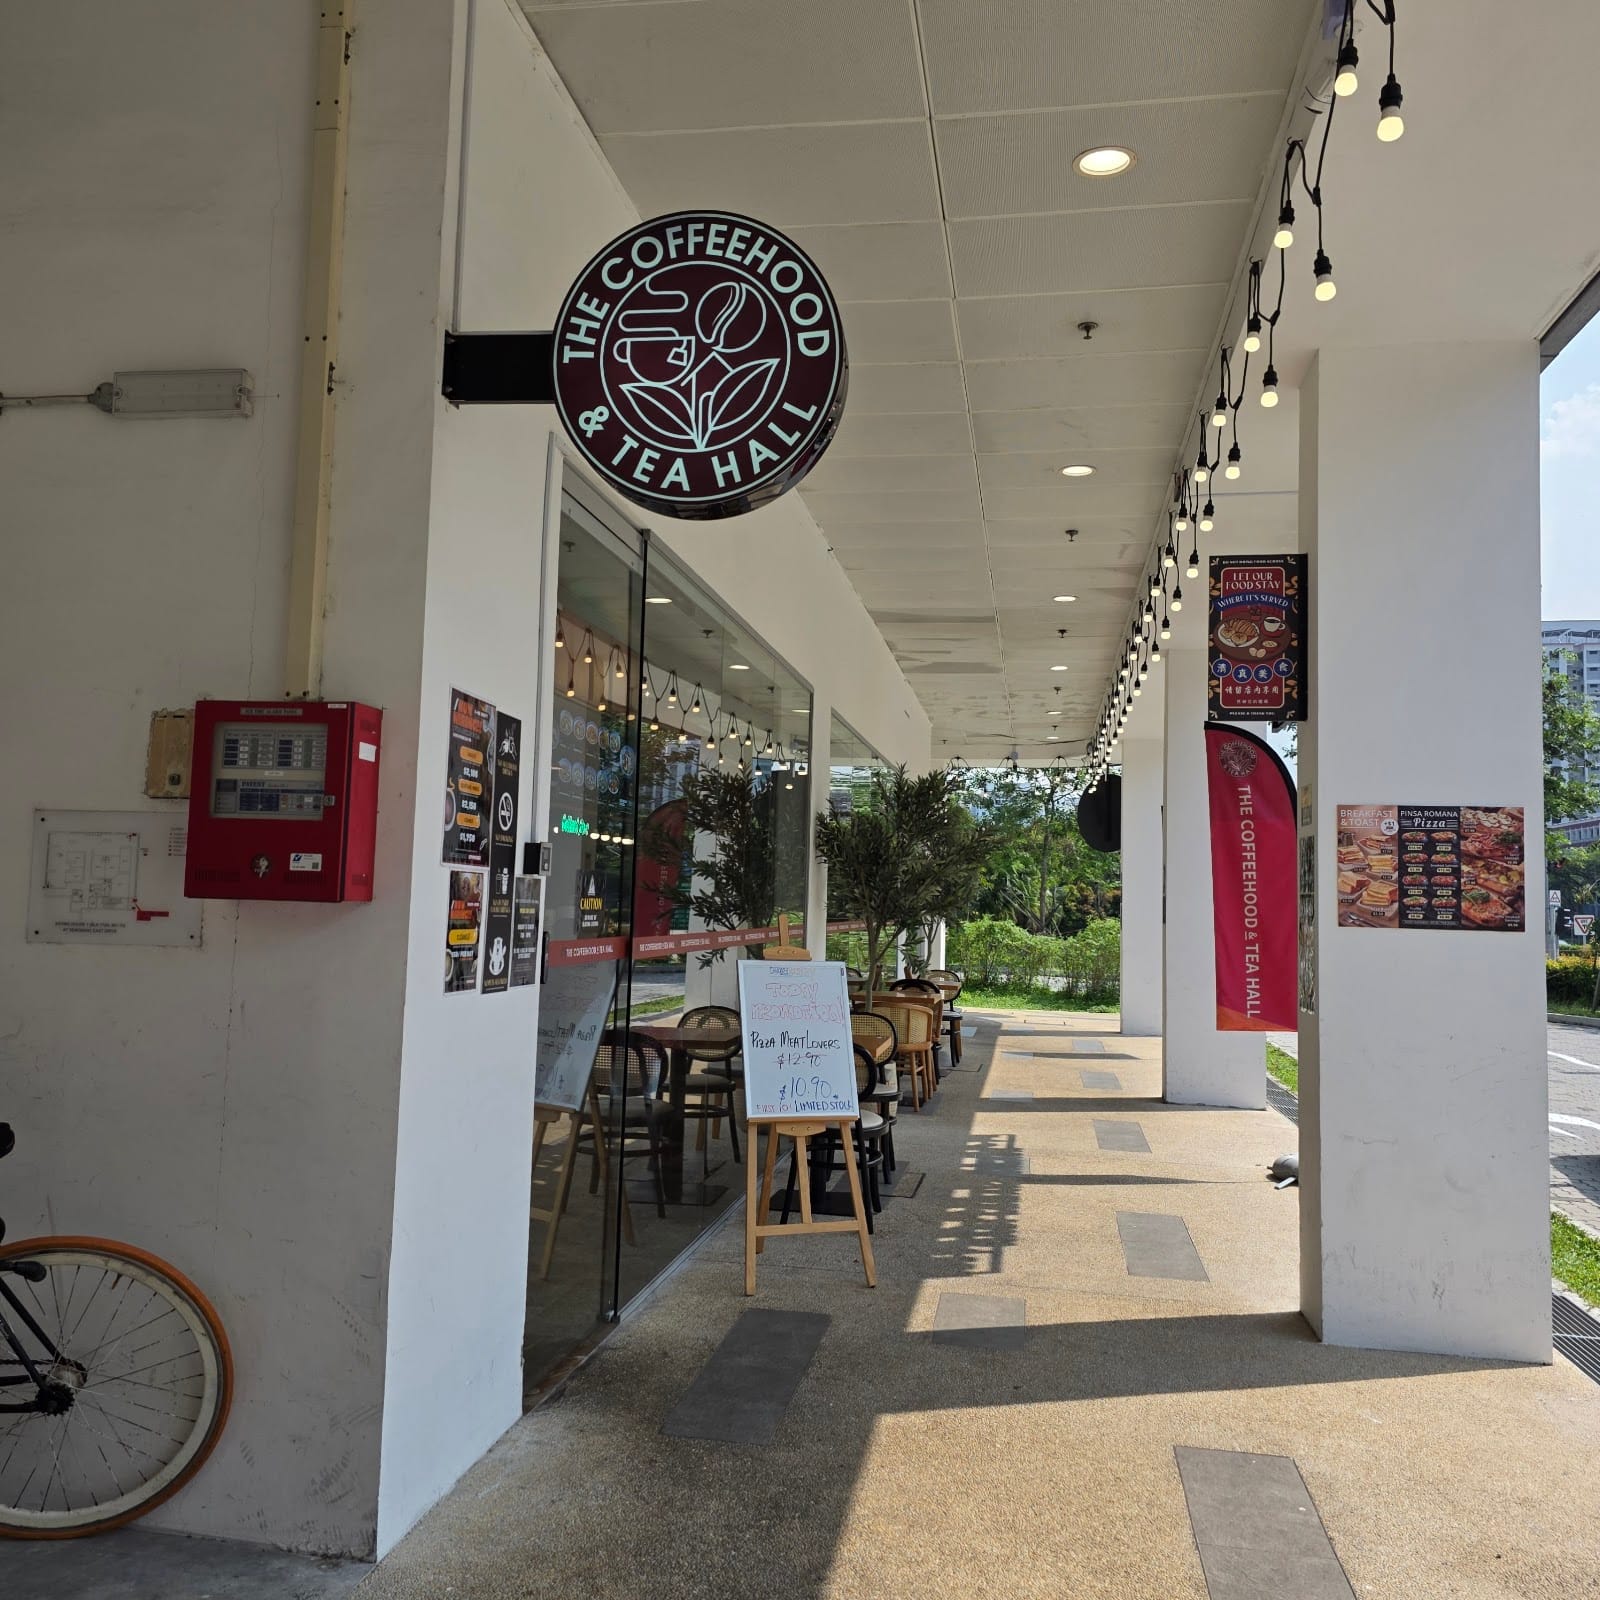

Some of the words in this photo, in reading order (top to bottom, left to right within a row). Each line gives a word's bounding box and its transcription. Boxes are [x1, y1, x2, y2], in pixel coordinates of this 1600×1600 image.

[562, 292, 610, 363] THE
[601, 223, 830, 357] COFFEEHOOD
[578, 405, 610, 438] &
[611, 434, 691, 492] TEA
[711, 401, 817, 488] HALL
[1233, 572, 1249, 581] LET
[1252, 572, 1273, 581] OUR
[1226, 581, 1254, 590] FOOD
[1255, 580, 1281, 589] STAY
[1217, 595, 1245, 608] WHERE
[1260, 594, 1289, 607] SERVED
[1237, 785, 1253, 816] THE
[1340, 809, 1393, 818] BREAKFAST
[1340, 818, 1348, 826] &
[1349, 818, 1379, 826] TOAST
[1413, 818, 1446, 828] Pizza
[1240, 820, 1258, 928] COFFEEHOOD
[580, 897, 603, 910] CAUTION
[1243, 930, 1258, 941] &
[1244, 943, 1260, 973] TEA
[766, 982, 818, 1001] TODAY
[1246, 977, 1261, 1018] HALL
[780, 1030, 806, 1048] MEAT
